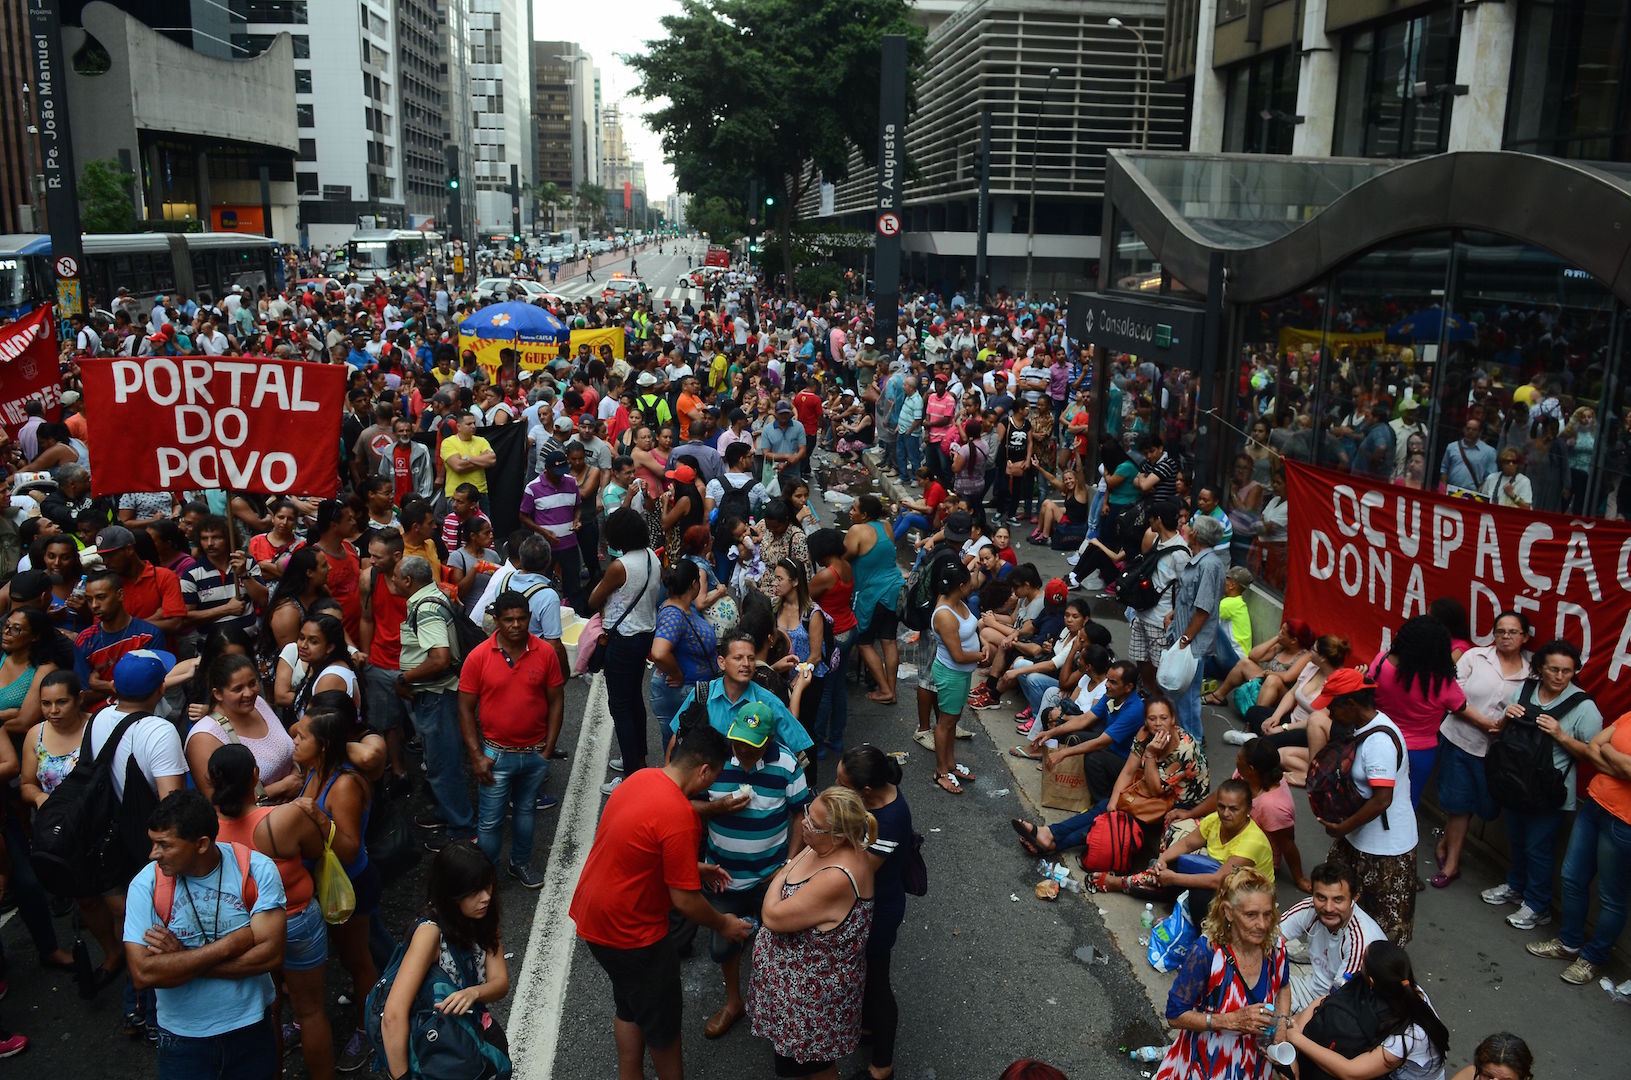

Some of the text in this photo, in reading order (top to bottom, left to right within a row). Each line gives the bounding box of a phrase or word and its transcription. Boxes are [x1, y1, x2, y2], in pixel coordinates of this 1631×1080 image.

[35, 34, 61, 188] R. Pe. João Manuel
[881, 124, 897, 208] R. Augusta
[111, 358, 320, 411] PORTAL
[174, 404, 248, 447] DO
[156, 446, 298, 492] POVO
[1309, 529, 1427, 619] DONA
